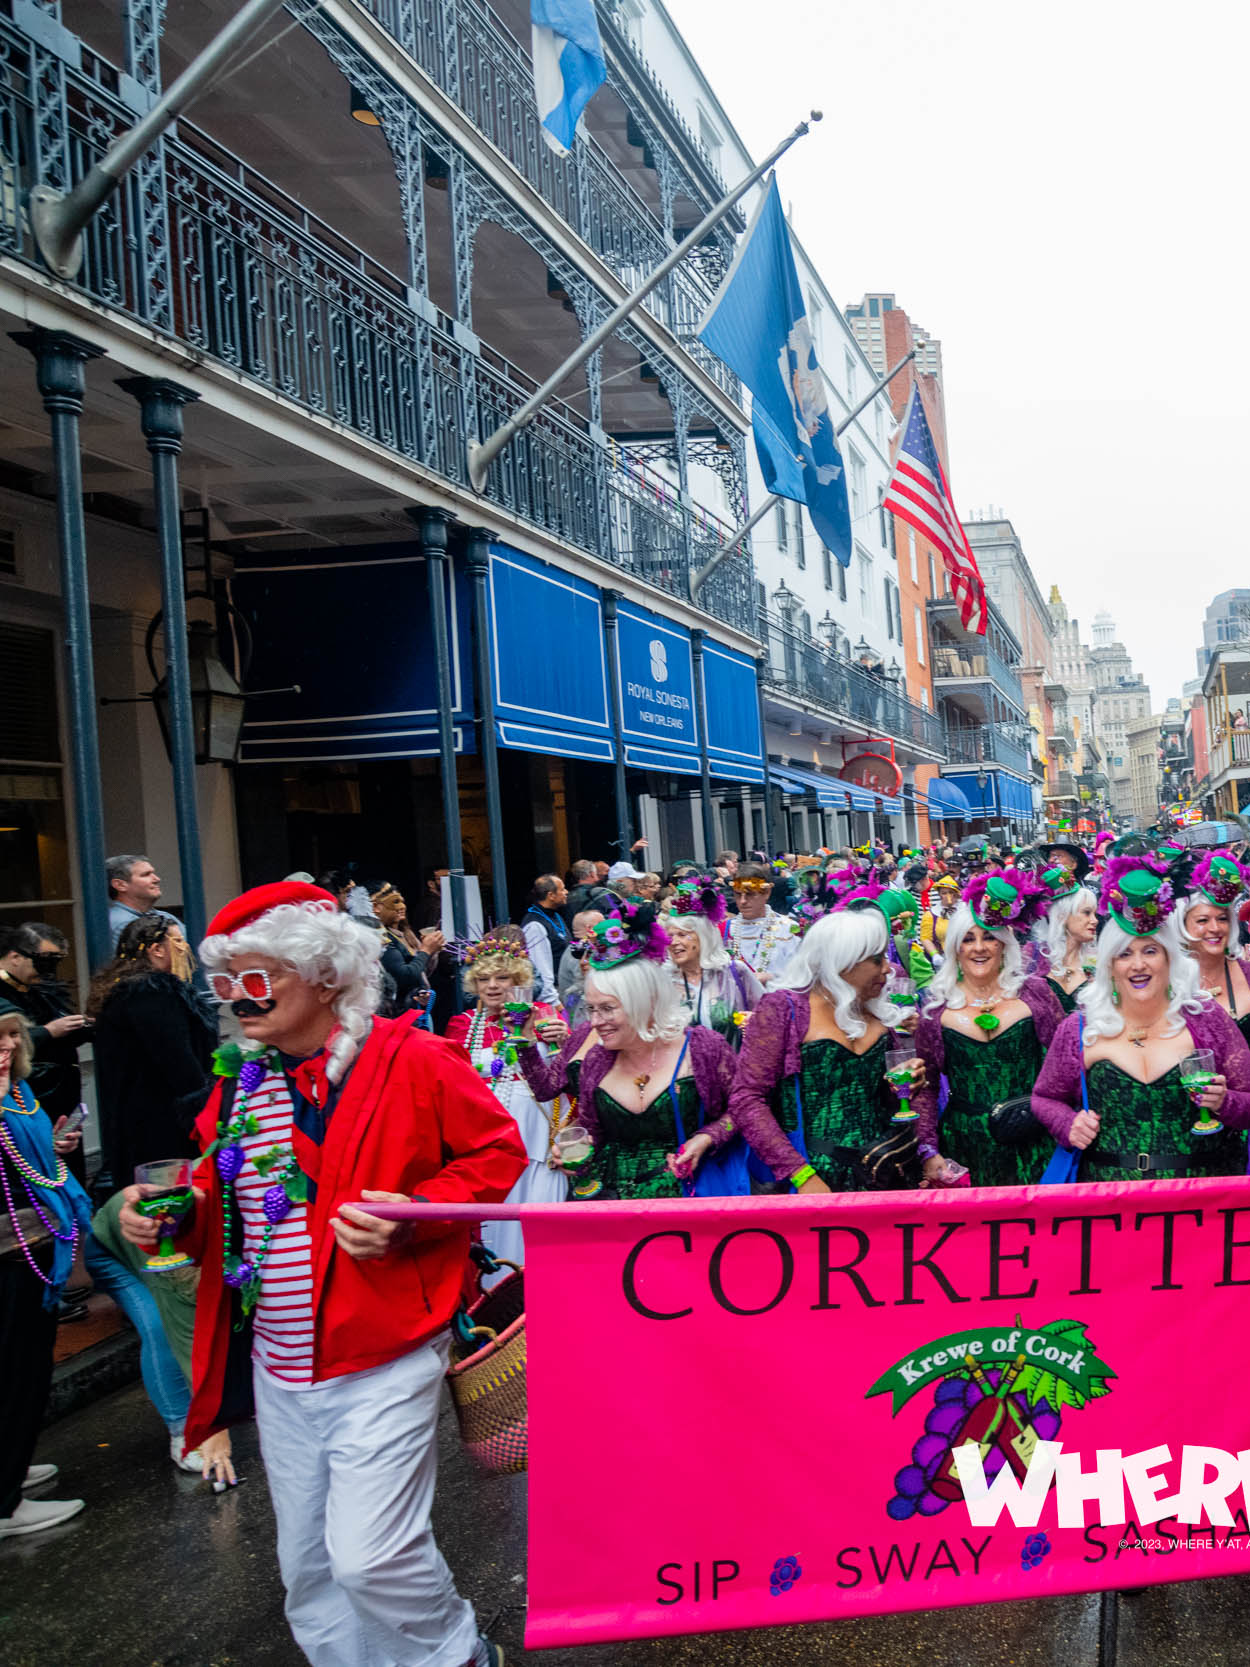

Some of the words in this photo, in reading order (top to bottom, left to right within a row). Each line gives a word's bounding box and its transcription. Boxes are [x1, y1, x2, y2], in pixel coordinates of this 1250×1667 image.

[627, 681, 656, 703] ROYAL
[655, 689, 689, 711] SONESTA
[639, 710, 655, 724] NEW
[655, 713, 684, 730] ORLEANS
[896, 1338, 985, 1387] Krewe
[991, 1331, 1022, 1353] of
[1024, 1334, 1087, 1375] Cork
[656, 1559, 740, 1606] SIP
[836, 1535, 993, 1589] SWAY
